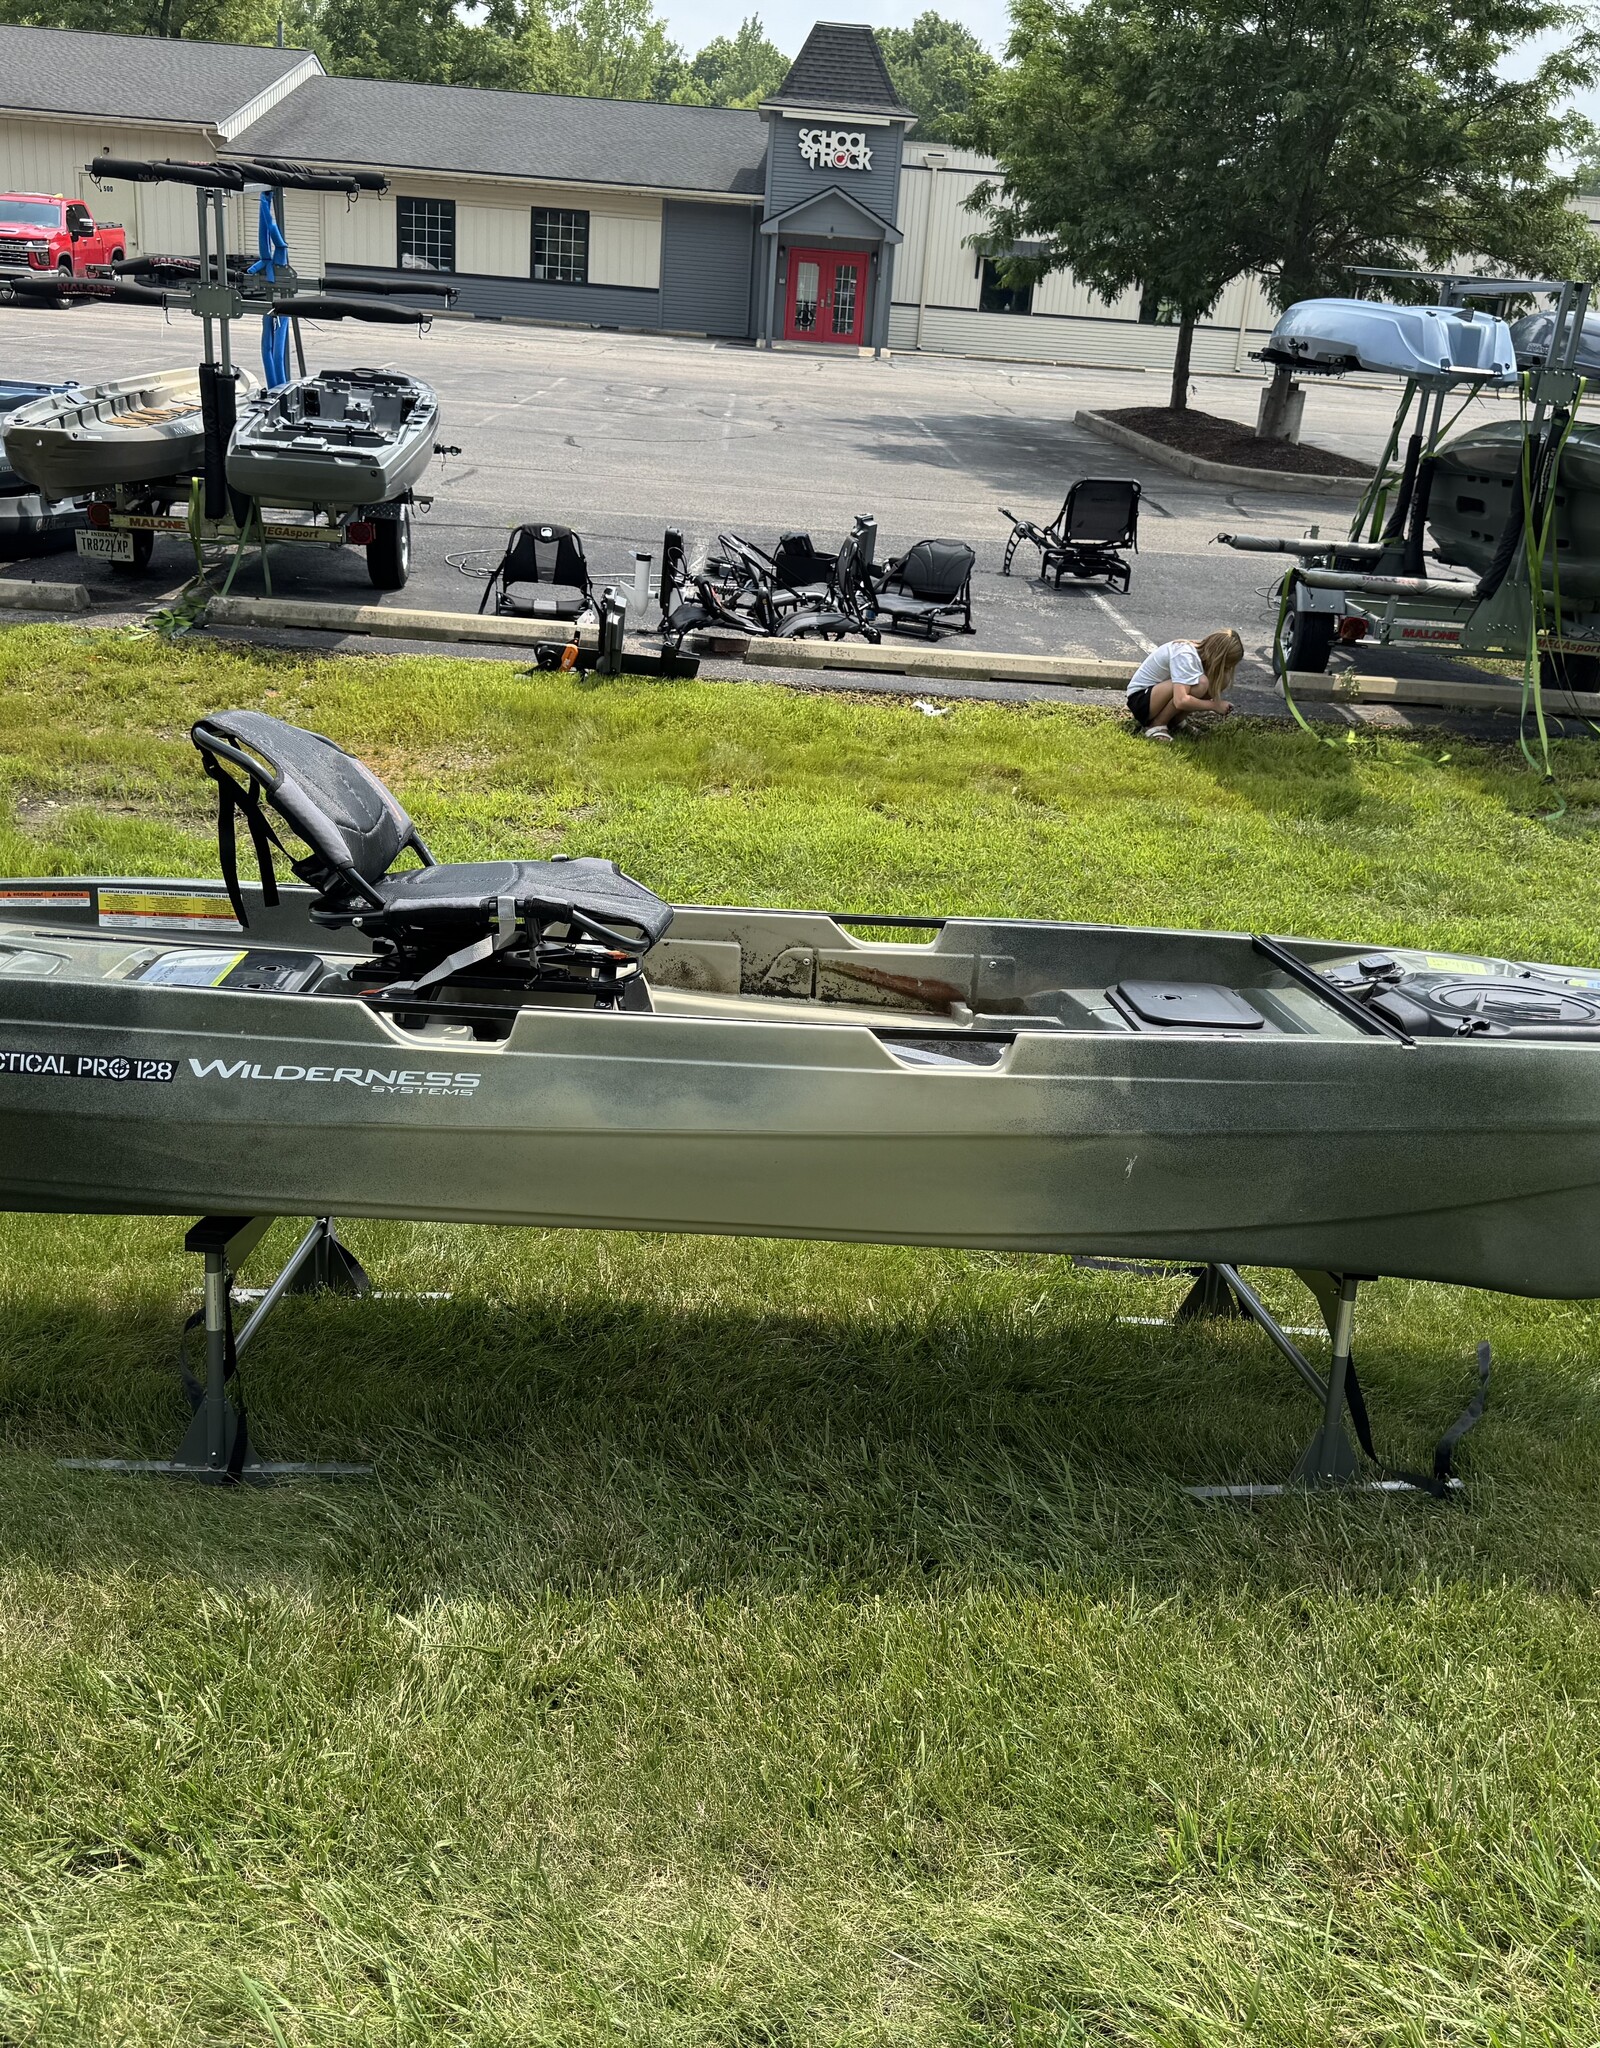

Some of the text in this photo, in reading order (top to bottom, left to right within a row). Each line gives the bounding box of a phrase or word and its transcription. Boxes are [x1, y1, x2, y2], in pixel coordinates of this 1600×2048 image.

[798, 128, 869, 152] SCHOOL
[800, 144, 873, 170] of ROCK
[103, 185, 114, 193] 500
[57, 283, 116, 294] MALONE
[129, 517, 186, 530] MALONE
[263, 526, 320, 539] EGAsport
[81, 537, 129, 554] TR822LXP
[1402, 628, 1460, 641] MALONE
[77, 1056, 130, 1079] PRO
[134, 1060, 173, 1080] 128
[188, 1058, 482, 1088] WILDERNESS
[371, 1085, 475, 1097] SYSTEMS
